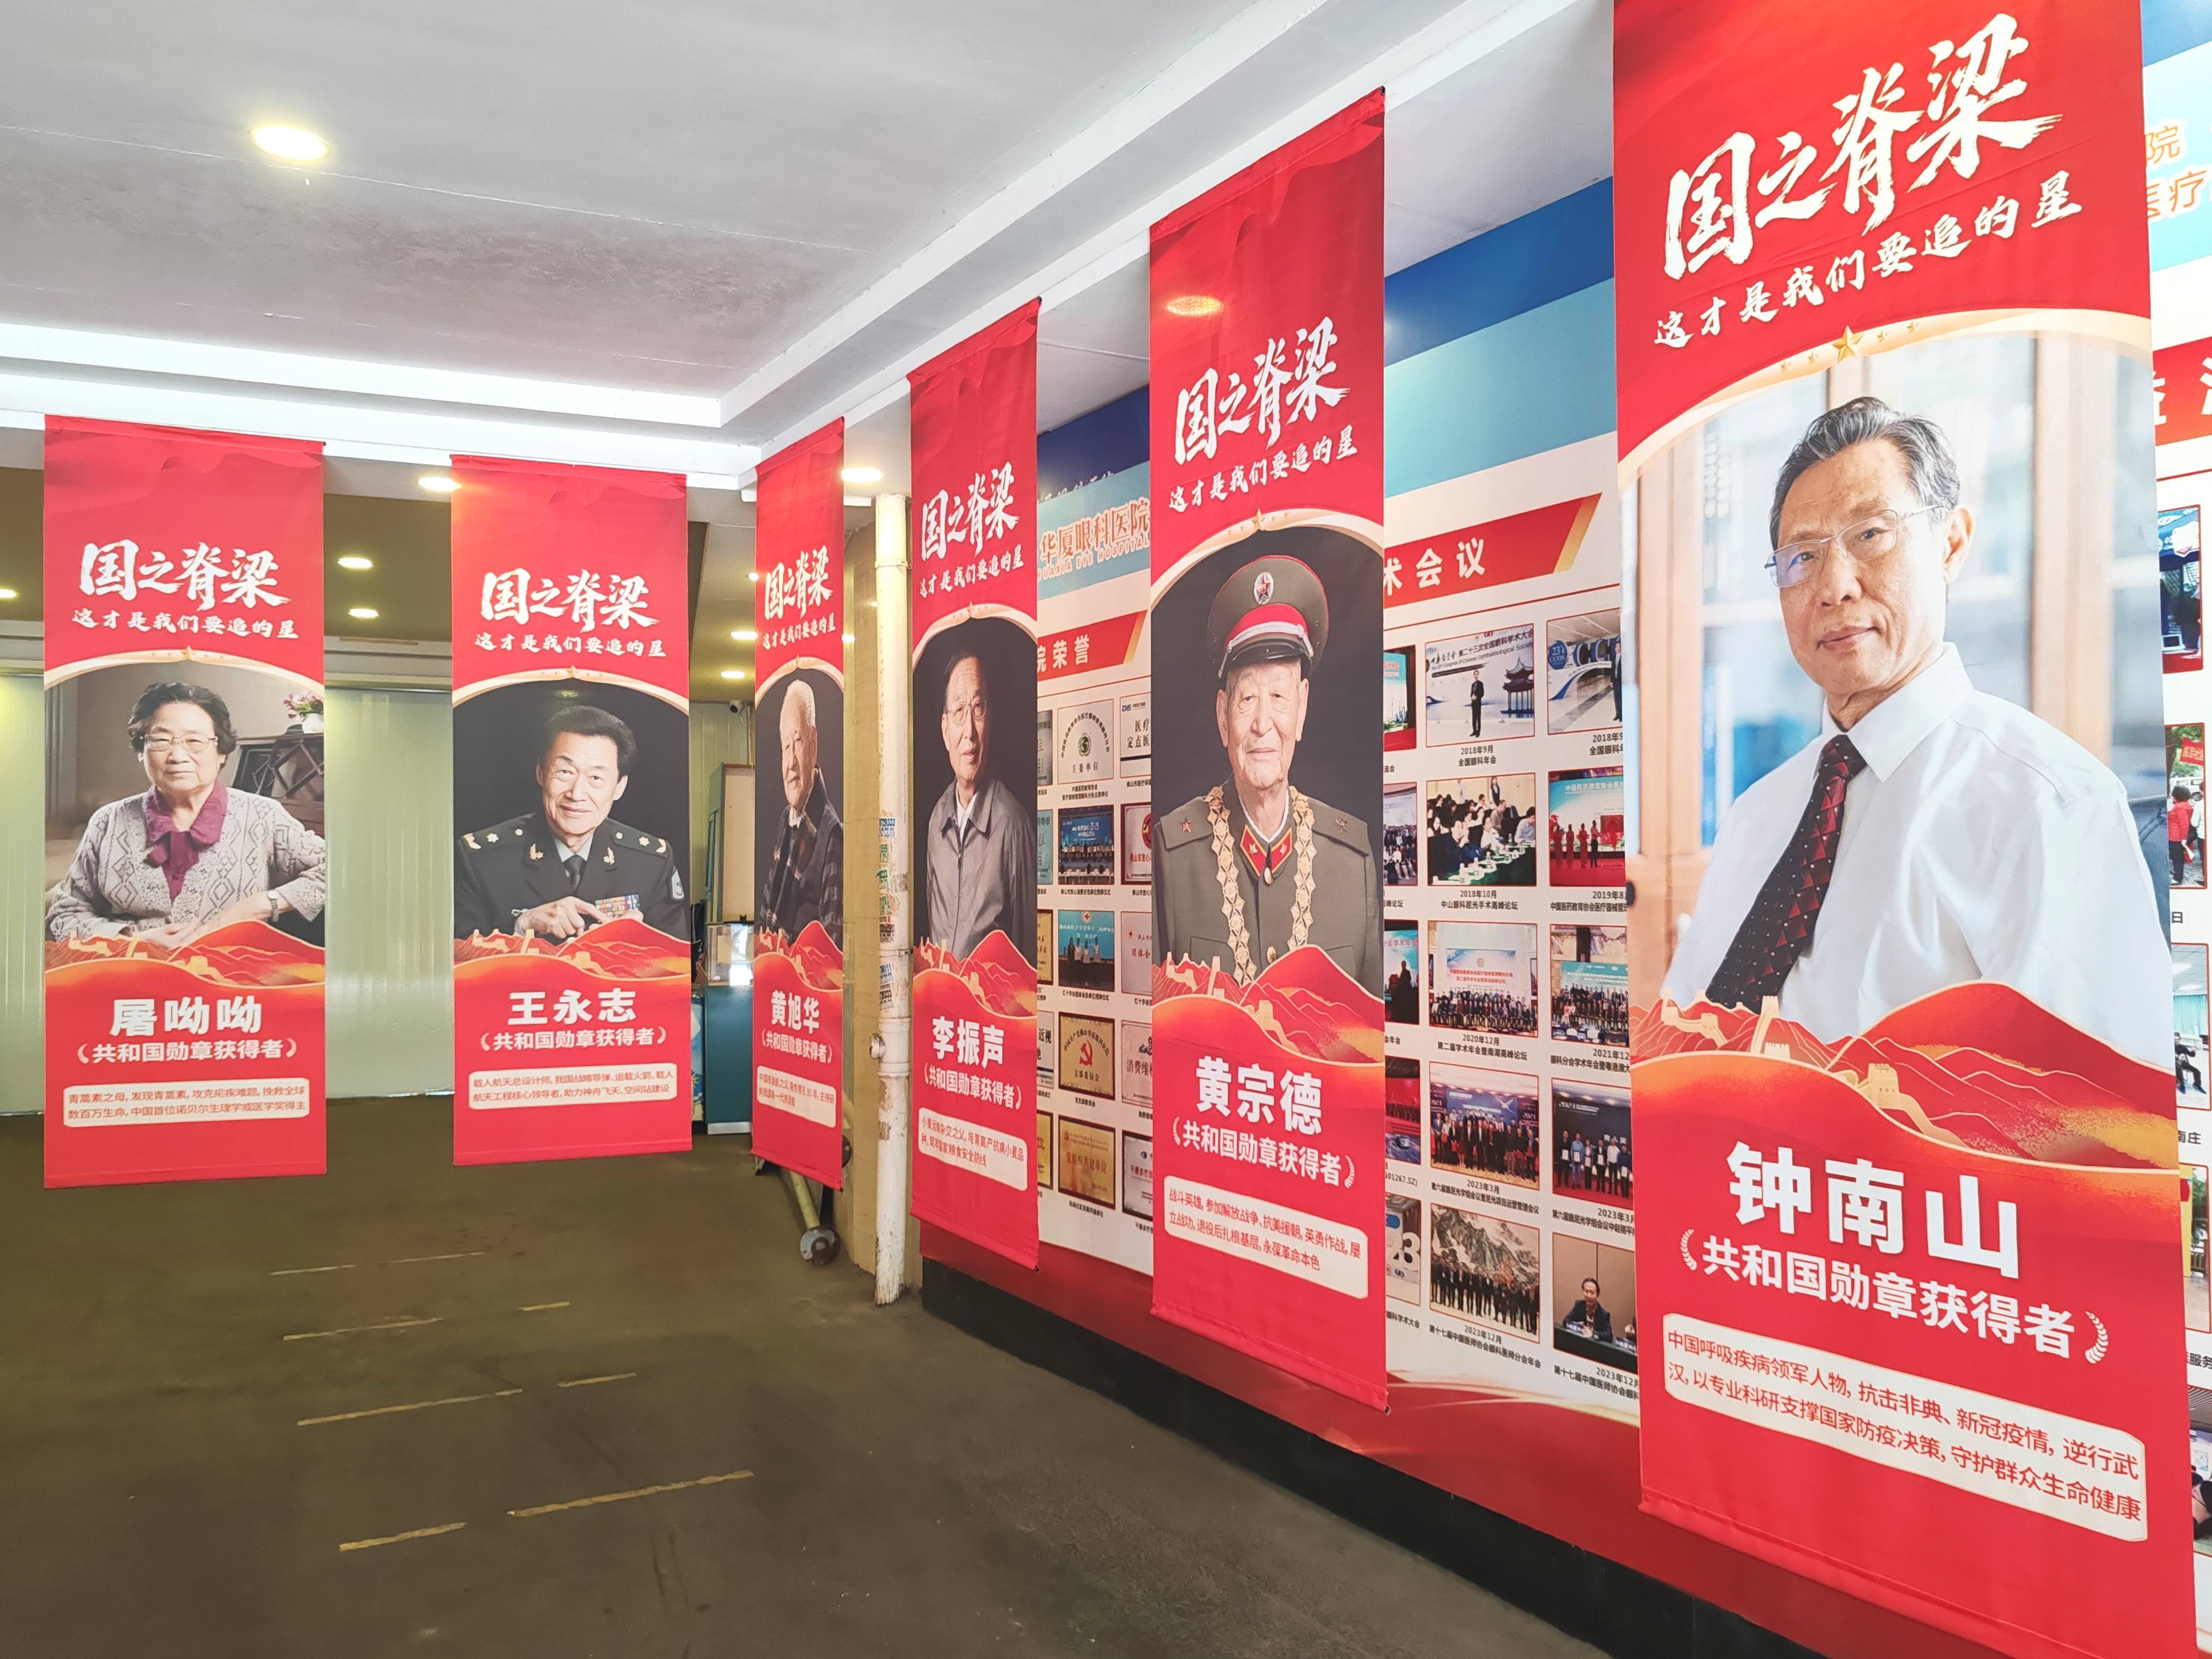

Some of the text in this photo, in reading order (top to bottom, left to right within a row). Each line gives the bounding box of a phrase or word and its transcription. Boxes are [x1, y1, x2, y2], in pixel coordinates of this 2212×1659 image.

[1664, 14, 2063, 279] 国之脊梁
[2145, 125, 2180, 164] 院
[1654, 171, 2082, 348] 这才是我们要追的星
[1175, 316, 1351, 465] 国之脊梁
[1169, 425, 1357, 512] 这才是我们要追的星
[921, 461, 1020, 562] 国之脊梁
[920, 544, 1023, 598] 这才是我们要追的星
[1078, 554, 1093, 567] EYE
[1098, 539, 1148, 560] HOSPITAL
[1384, 537, 1485, 596] 术会议
[79, 539, 291, 611] 国之脊梁
[765, 545, 834, 620] 国之脊梁
[481, 568, 661, 632] 国之脊梁
[71, 608, 299, 639] 这才是我们要追的星
[763, 612, 836, 650] 这才是我们要追的星
[475, 631, 667, 657] 这才是我们要追的星
[1037, 634, 1089, 673] 院荣誉
[1072, 761, 1099, 774] 主委单位
[1458, 755, 1496, 767] 全国眼科年会
[1460, 745, 1494, 755] 2018年9月
[1460, 890, 1497, 899] 2018年10月
[109, 996, 262, 1036] 屠呦呦
[508, 988, 636, 1025] 王永志
[771, 990, 820, 1034] 黄旭华
[93, 1039, 283, 1064] 共和国勋章获得者
[493, 1027, 655, 1050] 共和国勋章获得者
[766, 1030, 827, 1063] 共和国勋章获得者
[932, 1016, 1004, 1069] 李振声
[1463, 1034, 1500, 1046] 2020年12月
[1593, 1048, 1630, 1060] 2021年12
[929, 1067, 1015, 1109] 共和国勋章获得者
[1196, 1056, 1322, 1135] 黄宗德
[1183, 1120, 1342, 1187] 共和国勋章获得者
[1467, 1179, 1500, 1194] 2023年3月
[1726, 1141, 2019, 1279] 钟南山
[1702, 1236, 2074, 1359] 共和国勋章获得者
[1464, 1325, 1502, 1344] 2023年12月
[2186, 1351, 2212, 1369] 服务
[1668, 1330, 2139, 1480] 中国呼吸疾病领军人物，抗击非典、新冠疫情，逆行武
[1668, 1362, 2141, 1522] 汉，以专业科研支撑国家防疫决策，守护群众生命健康
